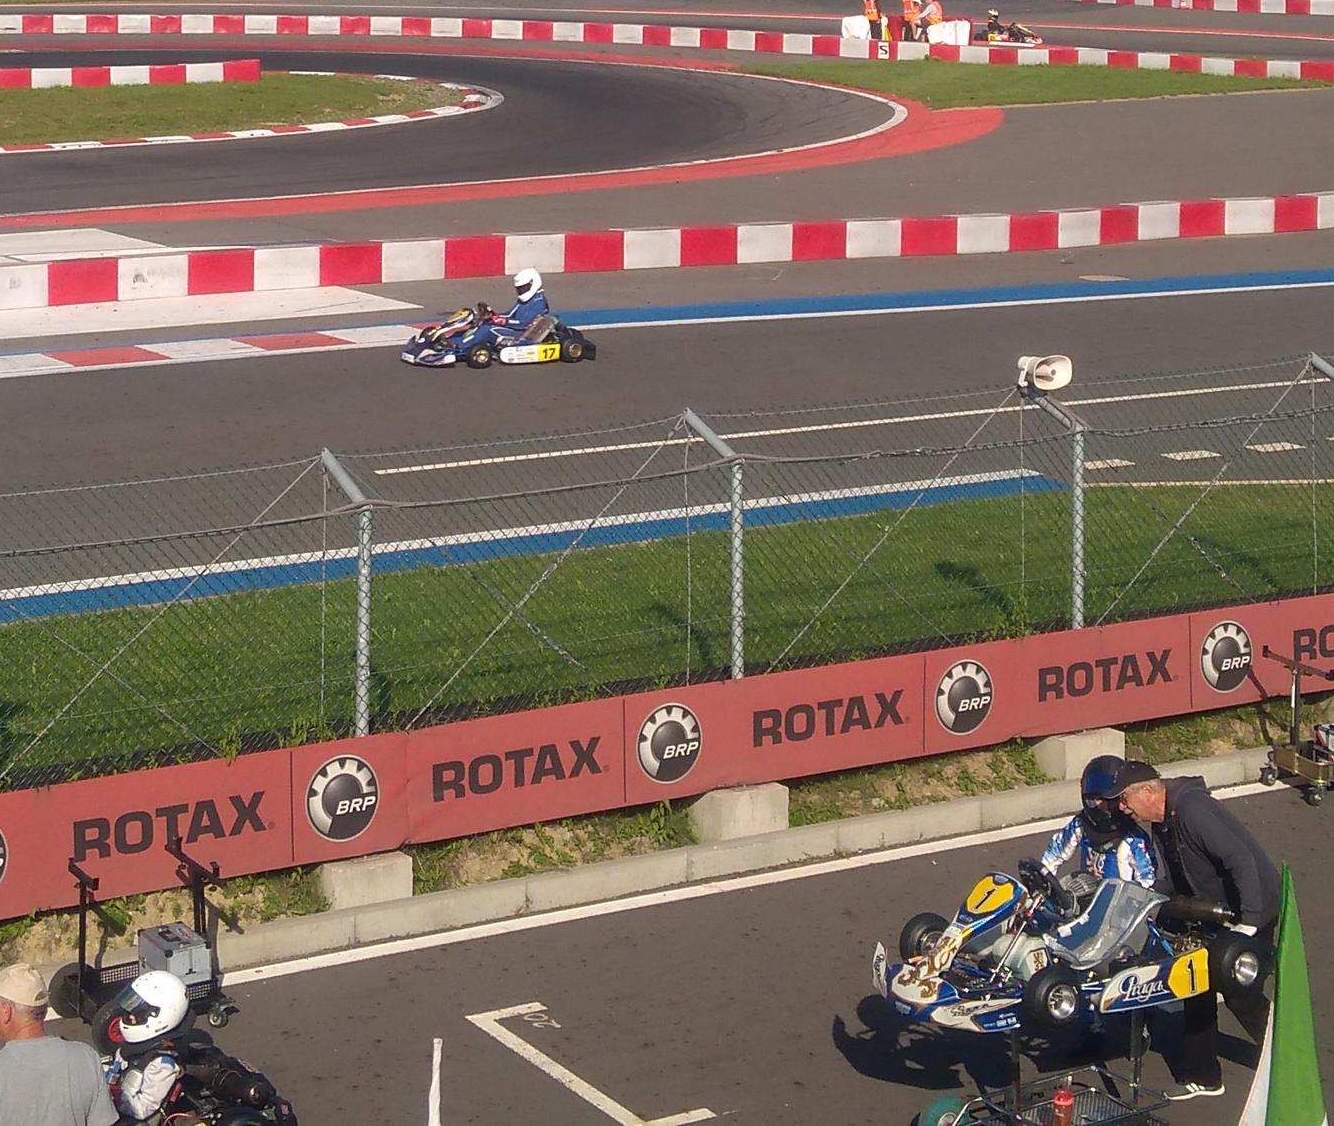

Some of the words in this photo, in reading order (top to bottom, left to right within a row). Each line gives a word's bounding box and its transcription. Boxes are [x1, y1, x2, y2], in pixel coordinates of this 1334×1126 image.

[542, 347, 556, 360] 17
[1221, 655, 1250, 671] BRP
[1037, 649, 1174, 703] ROTAX
[958, 694, 991, 712] BRP
[752, 690, 905, 748] ROTAX
[663, 741, 698, 759] BRP
[431, 736, 602, 802] ROTAX
[336, 795, 375, 815] BRP
[73, 791, 268, 863] ROTAX
[974, 886, 997, 910] 1
[1186, 957, 1197, 994] 1
